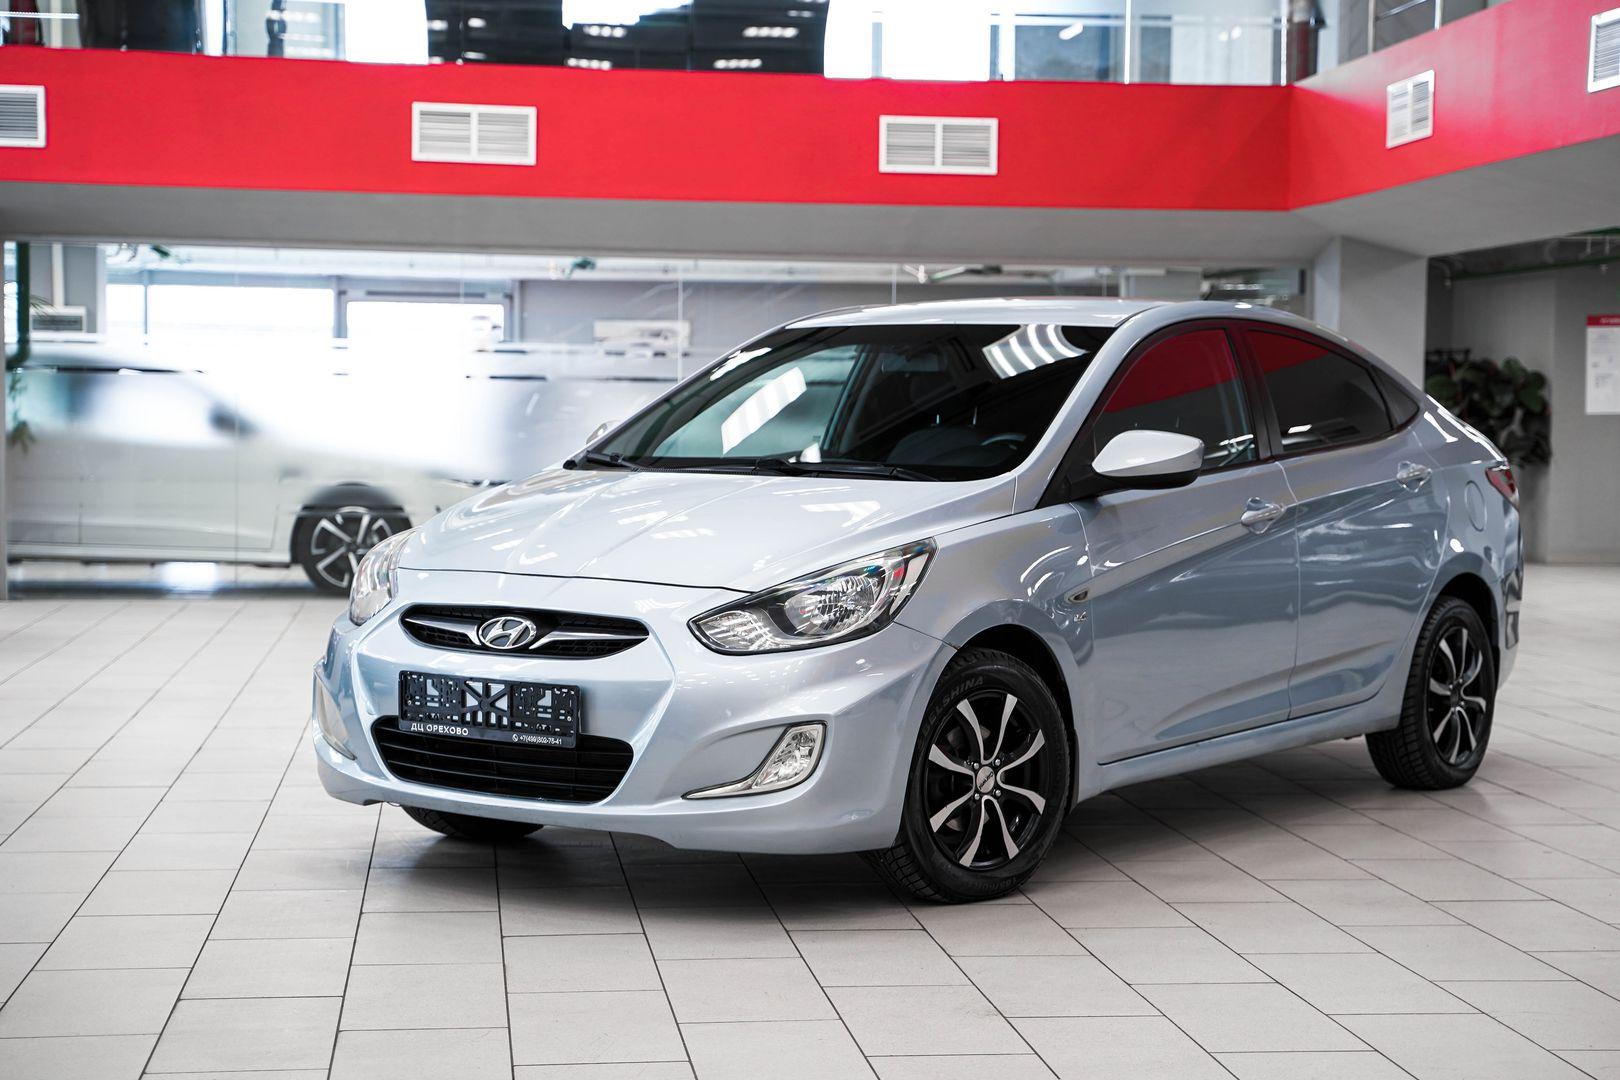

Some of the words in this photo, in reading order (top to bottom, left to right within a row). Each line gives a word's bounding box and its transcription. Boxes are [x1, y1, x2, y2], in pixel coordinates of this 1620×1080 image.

[921, 676, 984, 737] BELSHINA
[411, 722, 424, 733] ДЦ
[426, 724, 469, 736] ОРЕХОВО
